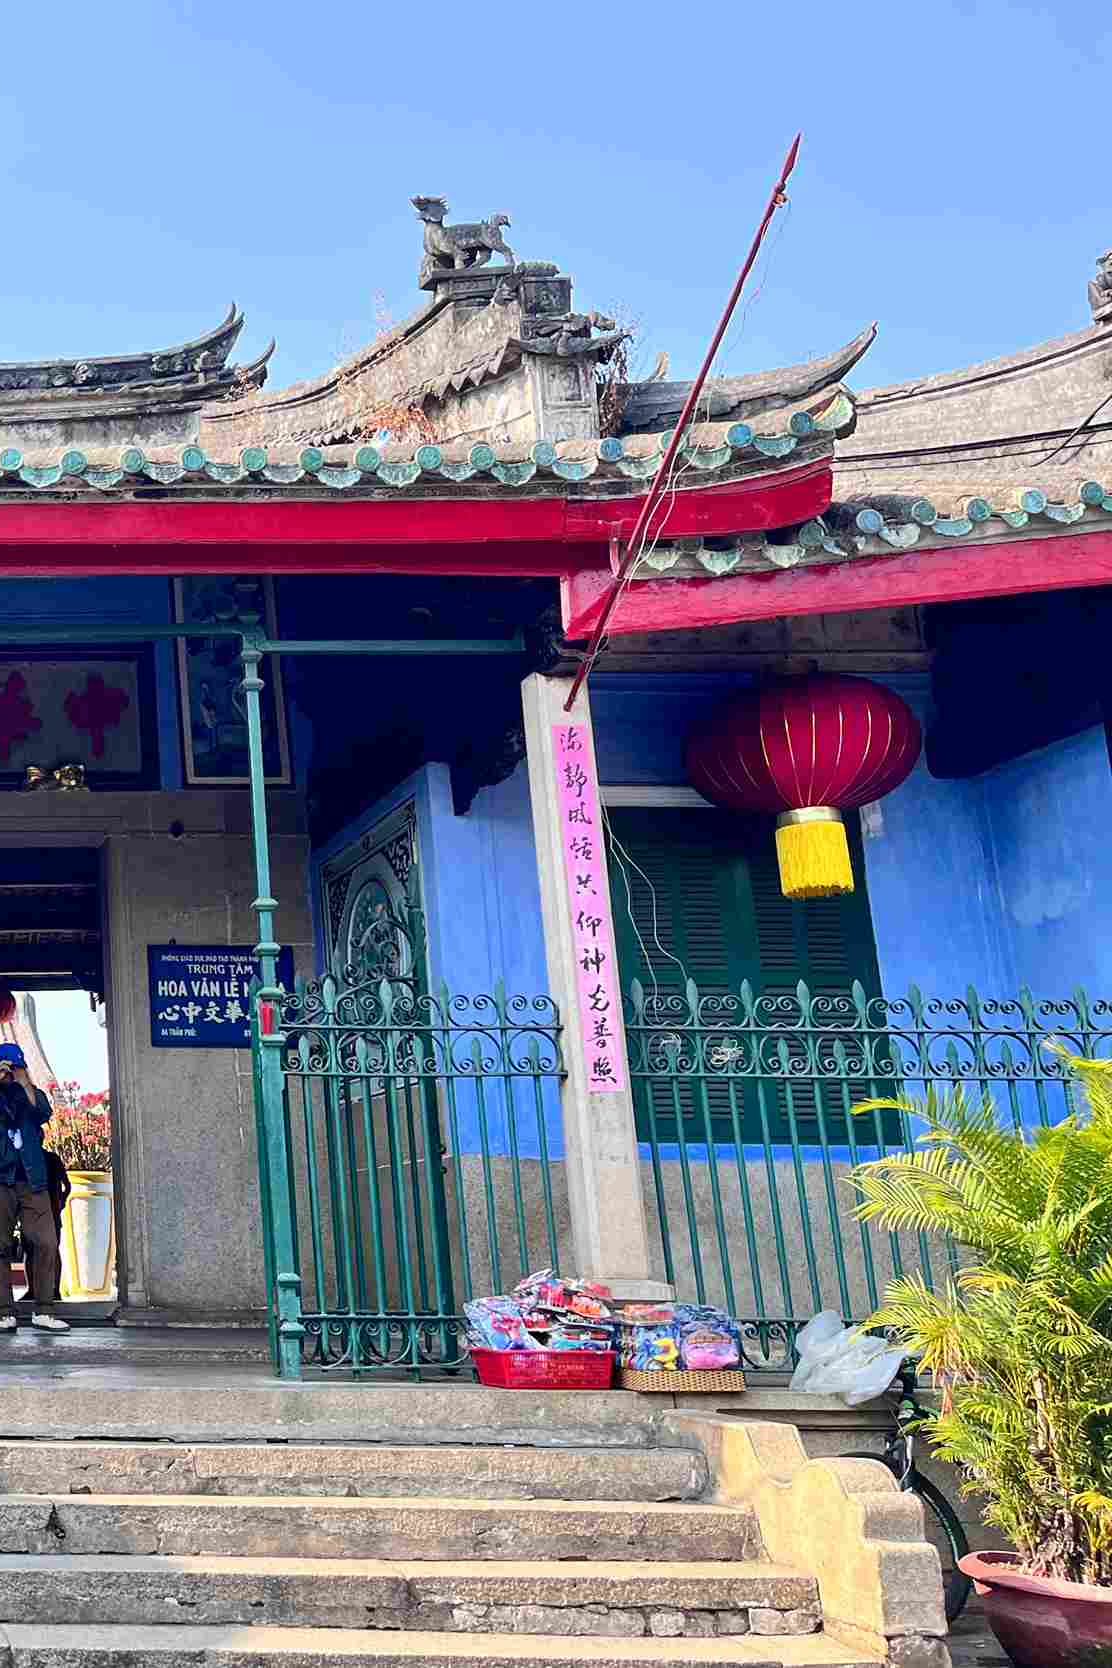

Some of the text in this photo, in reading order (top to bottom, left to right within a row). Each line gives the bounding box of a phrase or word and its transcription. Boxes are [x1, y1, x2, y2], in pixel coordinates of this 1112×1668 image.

[187, 963, 253, 975] TRUNG TÂM
[158, 980, 188, 997] HOA
[190, 977, 221, 997] VĂN
